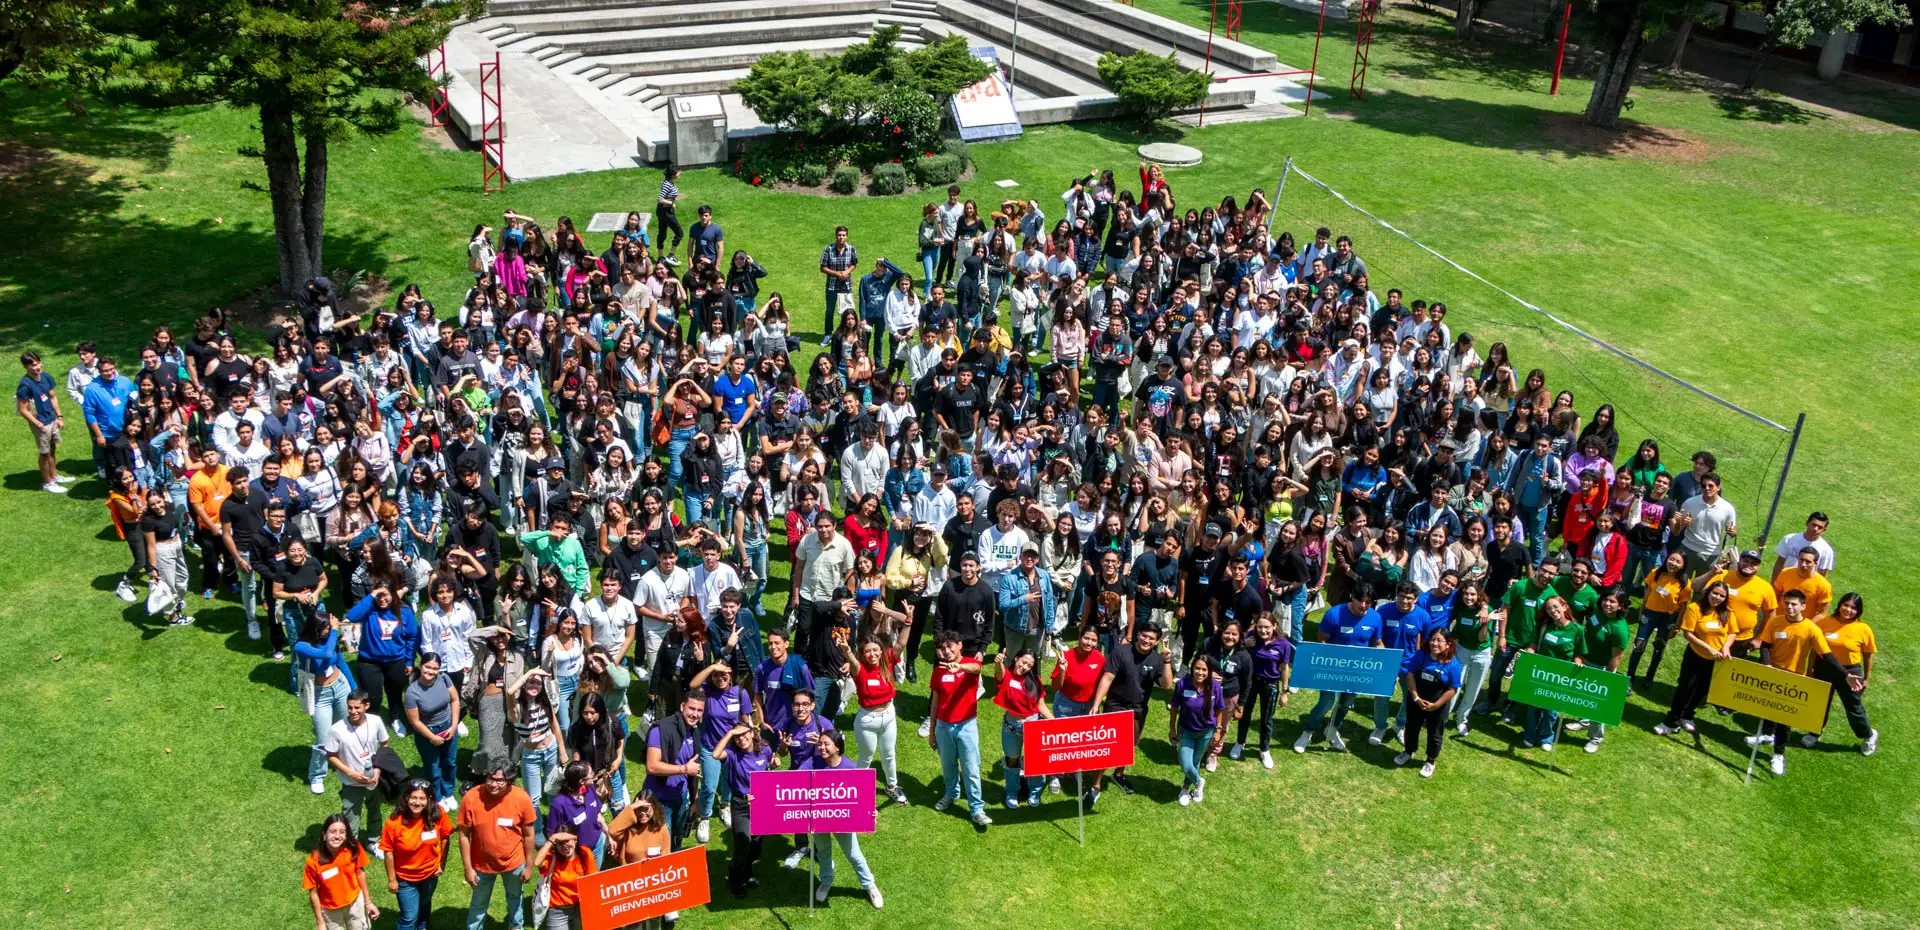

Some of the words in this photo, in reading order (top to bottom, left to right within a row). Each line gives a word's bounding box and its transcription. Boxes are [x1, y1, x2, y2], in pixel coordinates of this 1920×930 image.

[992, 545, 1018, 555] POLO
[1311, 652, 1383, 671] inmersión
[1313, 672, 1374, 684] ¡BIENVENIDOS!
[1532, 664, 1609, 696] inmersión
[1731, 668, 1809, 702] inmersión
[1534, 687, 1598, 709] ¡BIENVENIDOS!
[1733, 691, 1798, 715] ¡BIENVENIDOS!
[1041, 725, 1117, 746] inmersión
[1048, 748, 1111, 763] ¡BIENVENIDOS!
[775, 782, 858, 801] inmersión
[783, 809, 851, 822] ¡BIENVENIDOS!
[600, 865, 688, 899] inmersión
[610, 888, 682, 917] ¡BIENVENIDOS!
